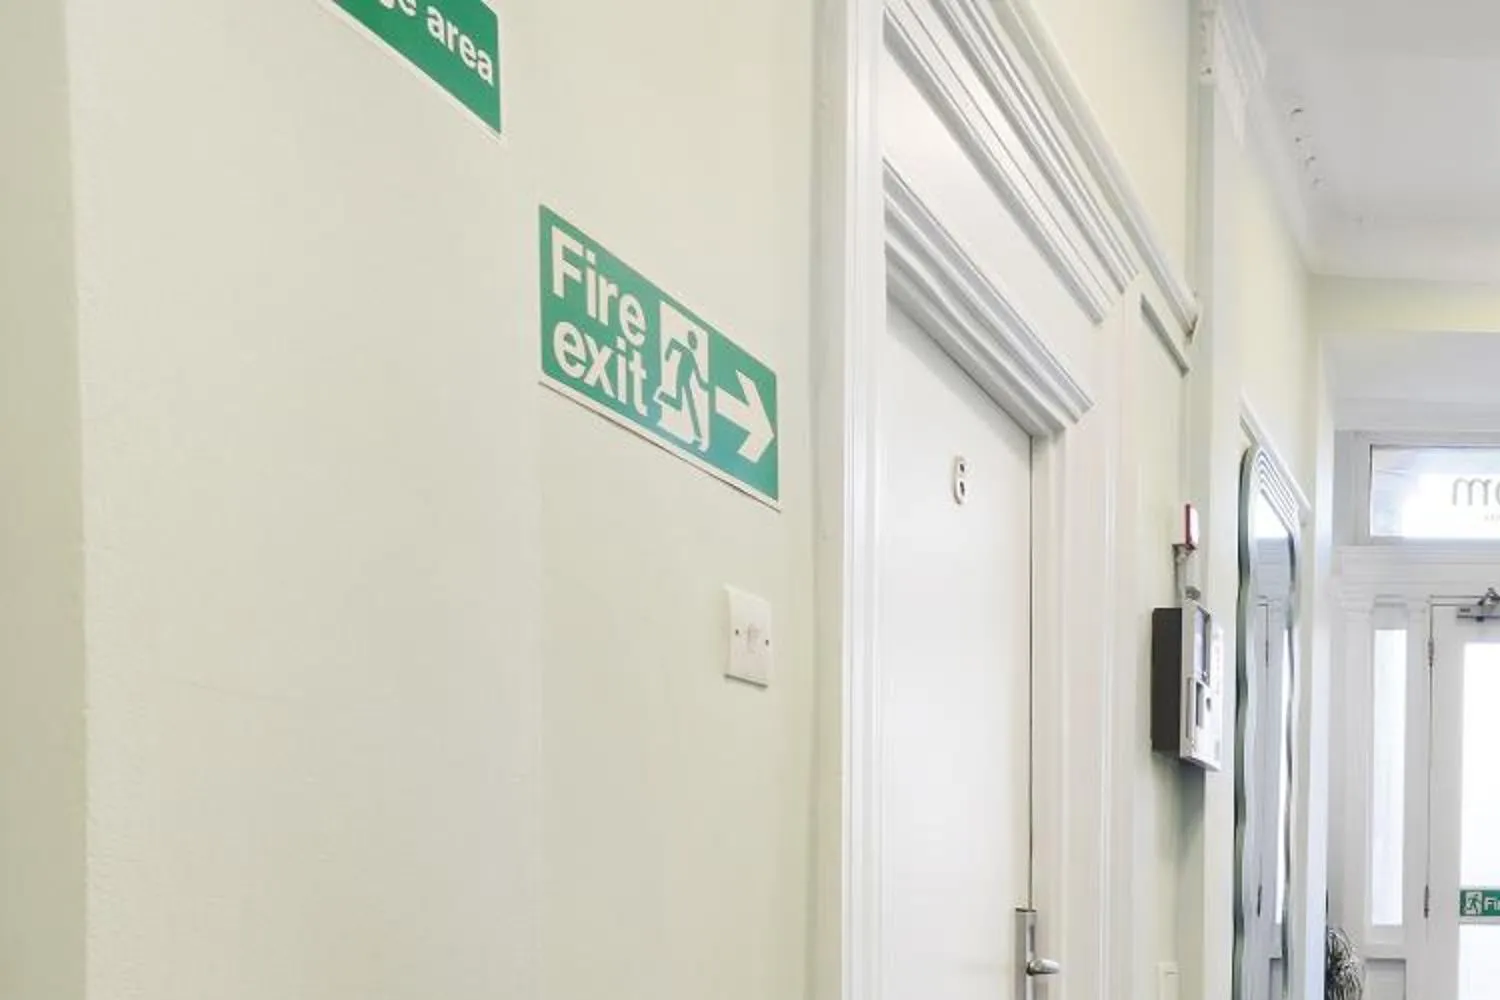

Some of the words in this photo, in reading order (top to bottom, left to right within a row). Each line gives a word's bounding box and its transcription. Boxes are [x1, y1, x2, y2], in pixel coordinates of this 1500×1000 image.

[426, 5, 494, 87] area
[551, 225, 647, 347] Fire
[553, 321, 648, 417] exit
